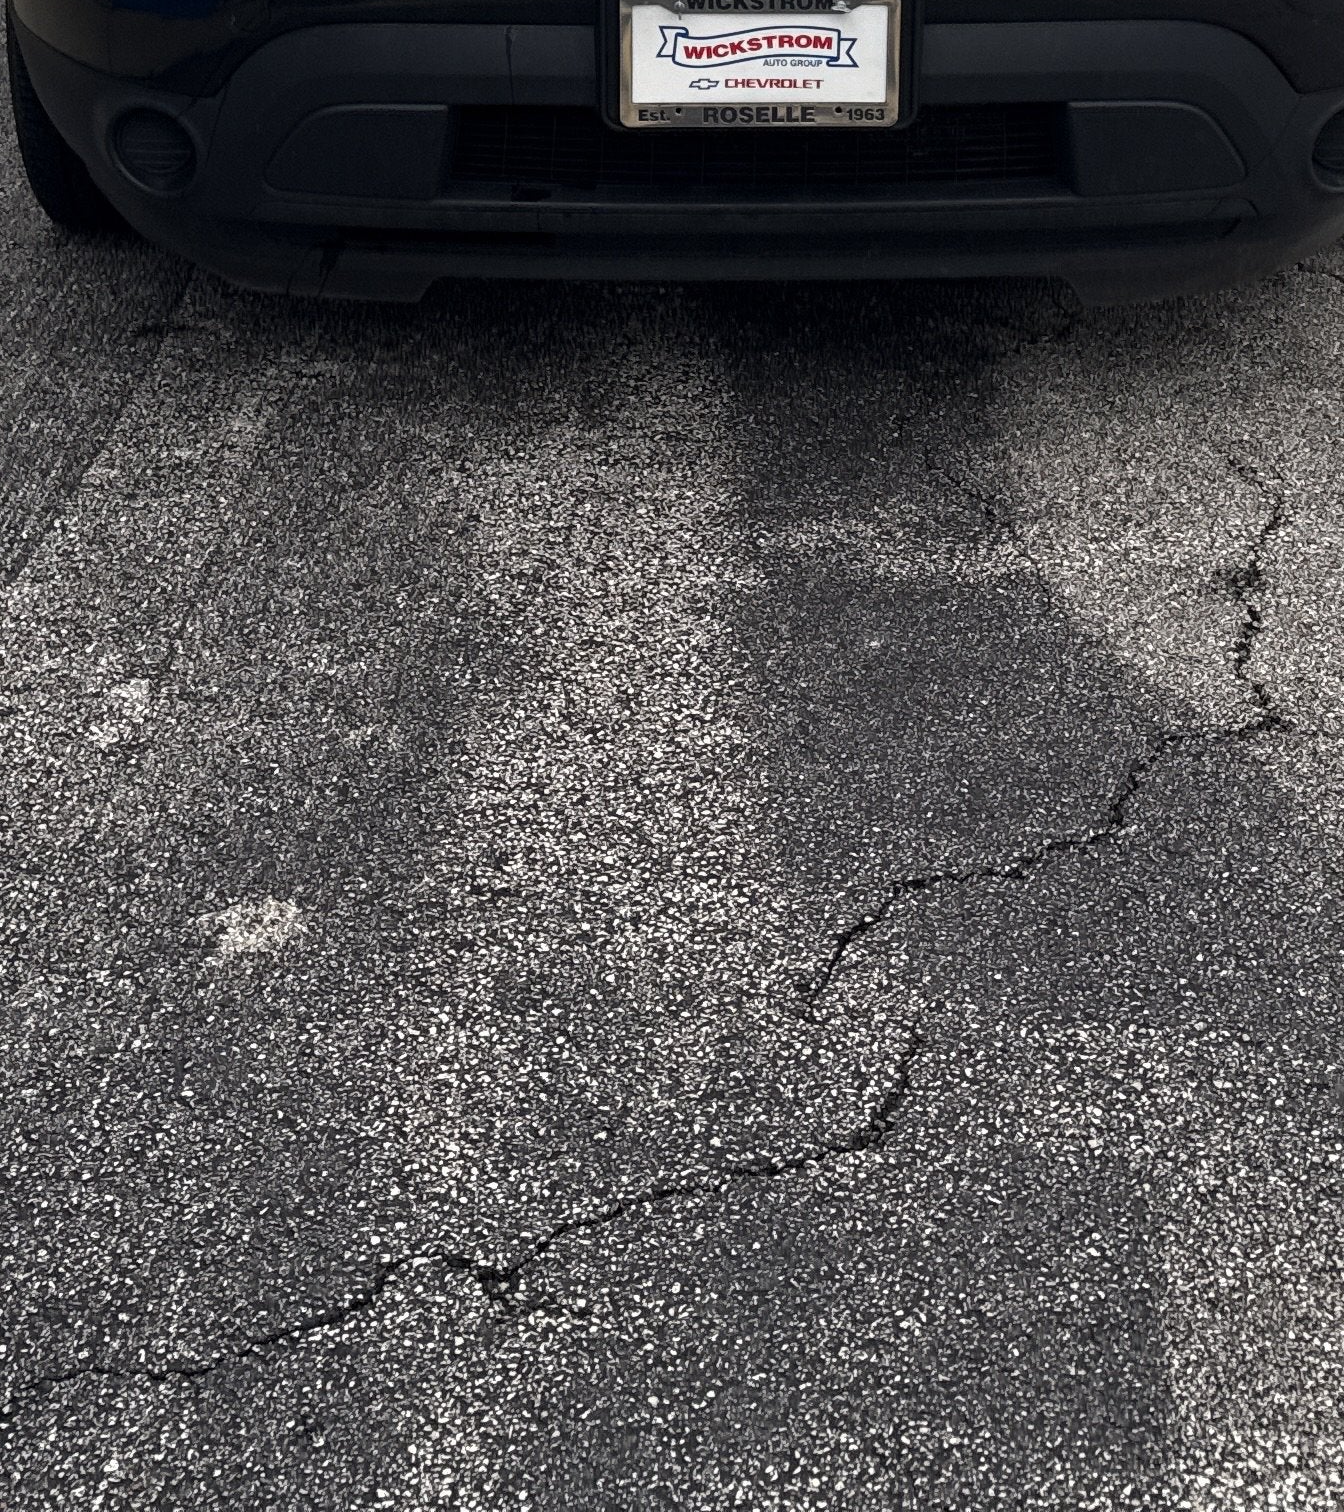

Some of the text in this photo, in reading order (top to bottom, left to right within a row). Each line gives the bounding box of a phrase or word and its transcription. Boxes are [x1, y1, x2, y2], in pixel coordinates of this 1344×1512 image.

[683, 35, 833, 60] WICKSTROM
[762, 58, 824, 67] AUTO GROUP
[724, 78, 825, 89] CHEVROLET
[638, 106, 885, 123] Est. ROSELLE 1963
